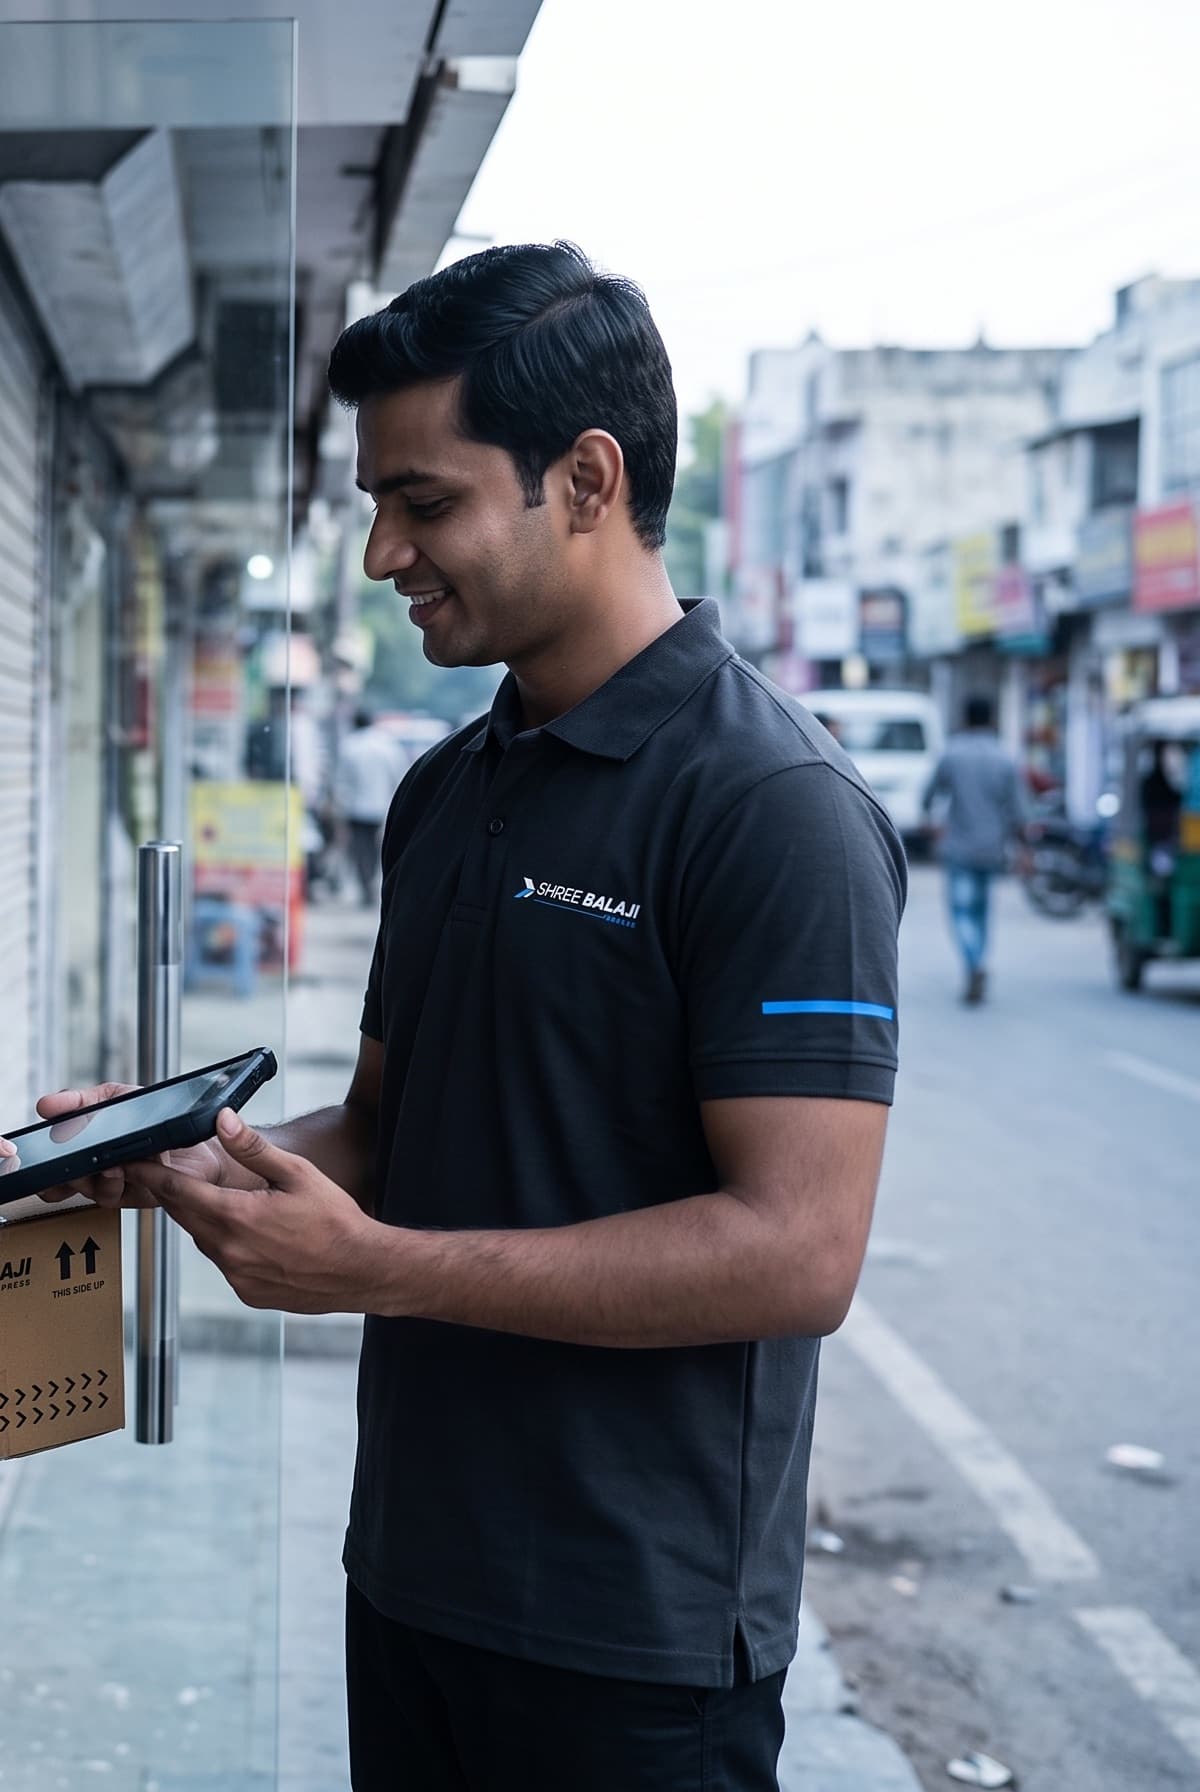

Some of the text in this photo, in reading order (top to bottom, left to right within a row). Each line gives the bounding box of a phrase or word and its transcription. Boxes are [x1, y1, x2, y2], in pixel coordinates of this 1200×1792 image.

[536, 882, 640, 919] SHREE BALAJI
[51, 1280, 105, 1299] THIS SIDE UP
